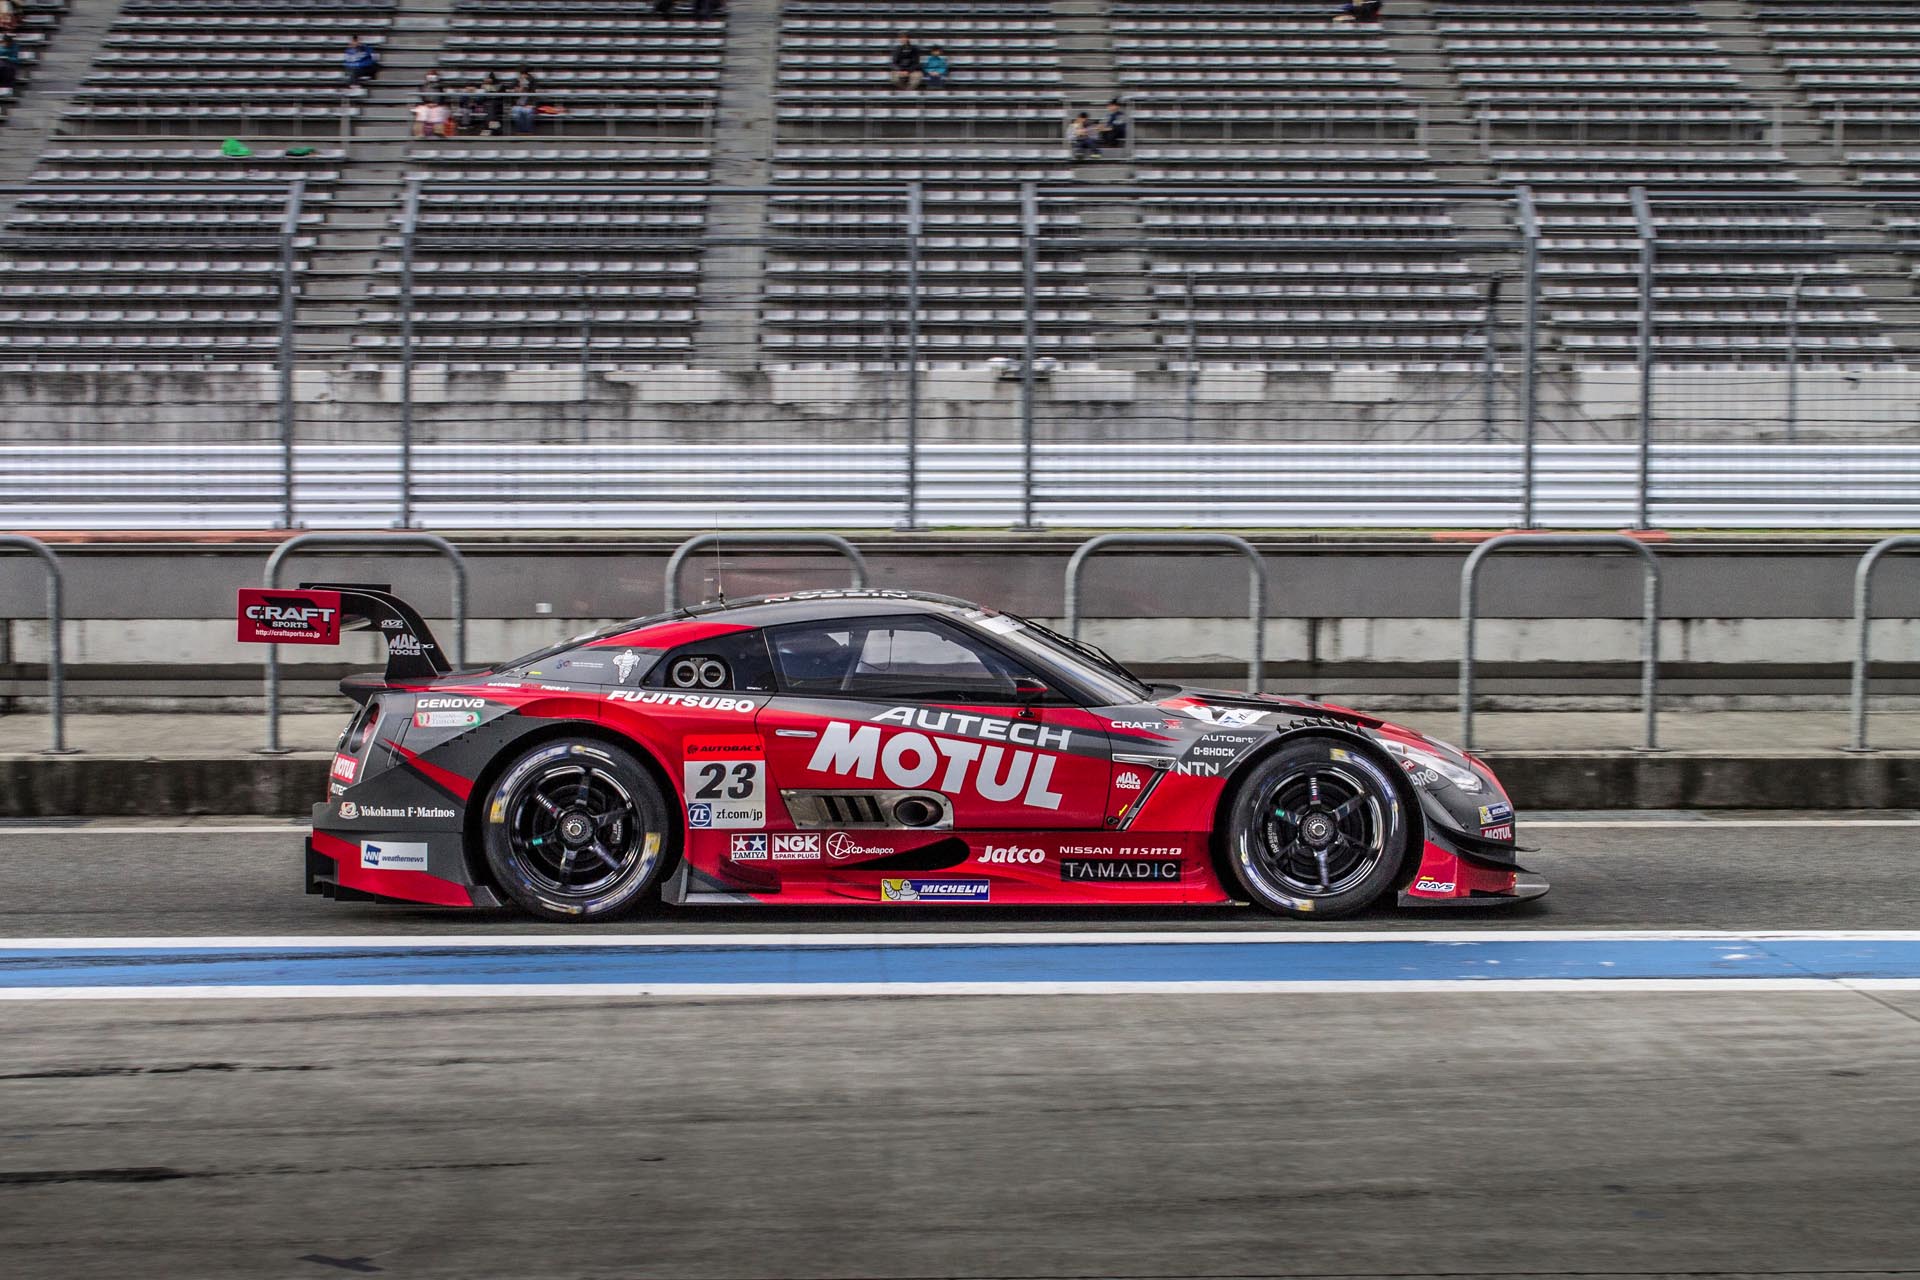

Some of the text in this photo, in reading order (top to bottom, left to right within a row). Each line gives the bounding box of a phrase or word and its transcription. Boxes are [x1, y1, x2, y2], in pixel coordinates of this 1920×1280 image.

[246, 606, 335, 622] CRAFT
[255, 629, 320, 638] http://craftsports.co.jp
[390, 634, 420, 649] MAC
[607, 690, 755, 713] FUJITSUBO
[870, 706, 1072, 750] AUTECH
[1111, 720, 1161, 730] CRAFT
[1201, 734, 1253, 743] AUTOart
[1194, 746, 1235, 757] G-SHOCK
[334, 757, 356, 779] MOTUL
[807, 720, 1063, 810] MOTUL
[1177, 761, 1219, 777] NTN
[695, 763, 756, 799] 23
[1115, 772, 1141, 784] MAC
[360, 805, 406, 817] Yokohama
[691, 809, 707, 822] ZF
[716, 808, 763, 821] zf.com/jp
[1484, 826, 1512, 840] MOTUL
[775, 835, 819, 852] NGK
[733, 851, 766, 859] TAMIYA
[851, 847, 894, 855] CD-adapco
[978, 846, 1045, 863] Jatco
[1060, 846, 1182, 855] NISSAN nismo
[382, 855, 424, 863] weathernews
[1065, 862, 1176, 878] TAMADIC
[920, 884, 988, 894] MICHELIN
[1418, 882, 1453, 890] RAYS
